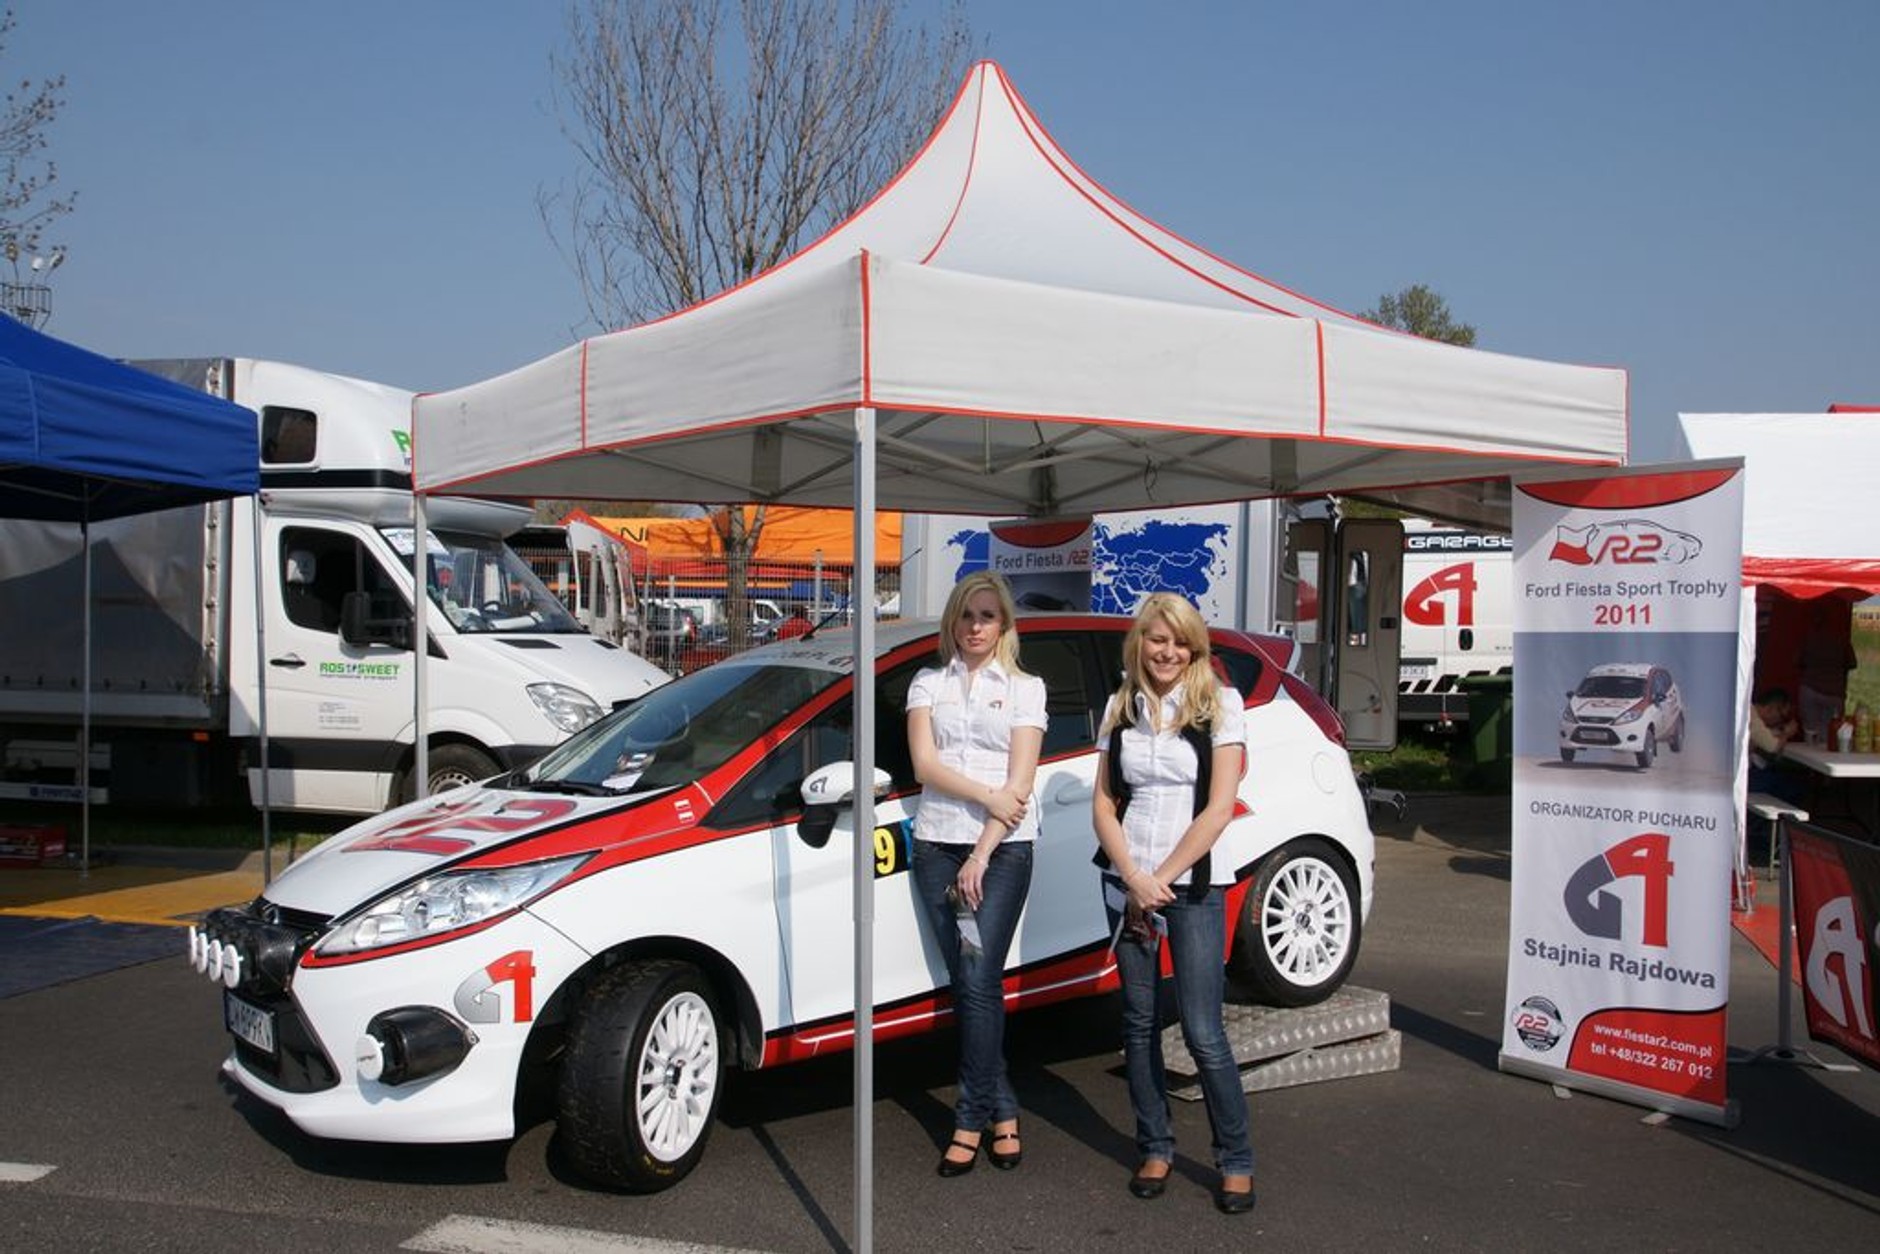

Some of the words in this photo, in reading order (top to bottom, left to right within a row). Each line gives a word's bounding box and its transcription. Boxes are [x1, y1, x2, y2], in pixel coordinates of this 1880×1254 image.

[995, 554, 1024, 568] Ford
[1026, 552, 1062, 567] Fiesta
[1525, 583, 1560, 597] Ford
[1565, 582, 1612, 597] Fiesta
[1616, 581, 1663, 598] Sport
[1667, 579, 1728, 598] Trophy
[1595, 603, 1652, 625] 2011
[1530, 800, 1633, 823] ORGANIZATOR
[1638, 810, 1717, 831] PUCHARU
[1524, 938, 1601, 968] Stajnia
[1609, 952, 1716, 989] Rajdowa
[1593, 1024, 1713, 1059] www.fiestar2.com.pl
[1591, 1042, 1606, 1055] tel
[1609, 1047, 1657, 1067] +48/322
[1661, 1057, 1685, 1072] 267
[1688, 1063, 1713, 1079] 012
